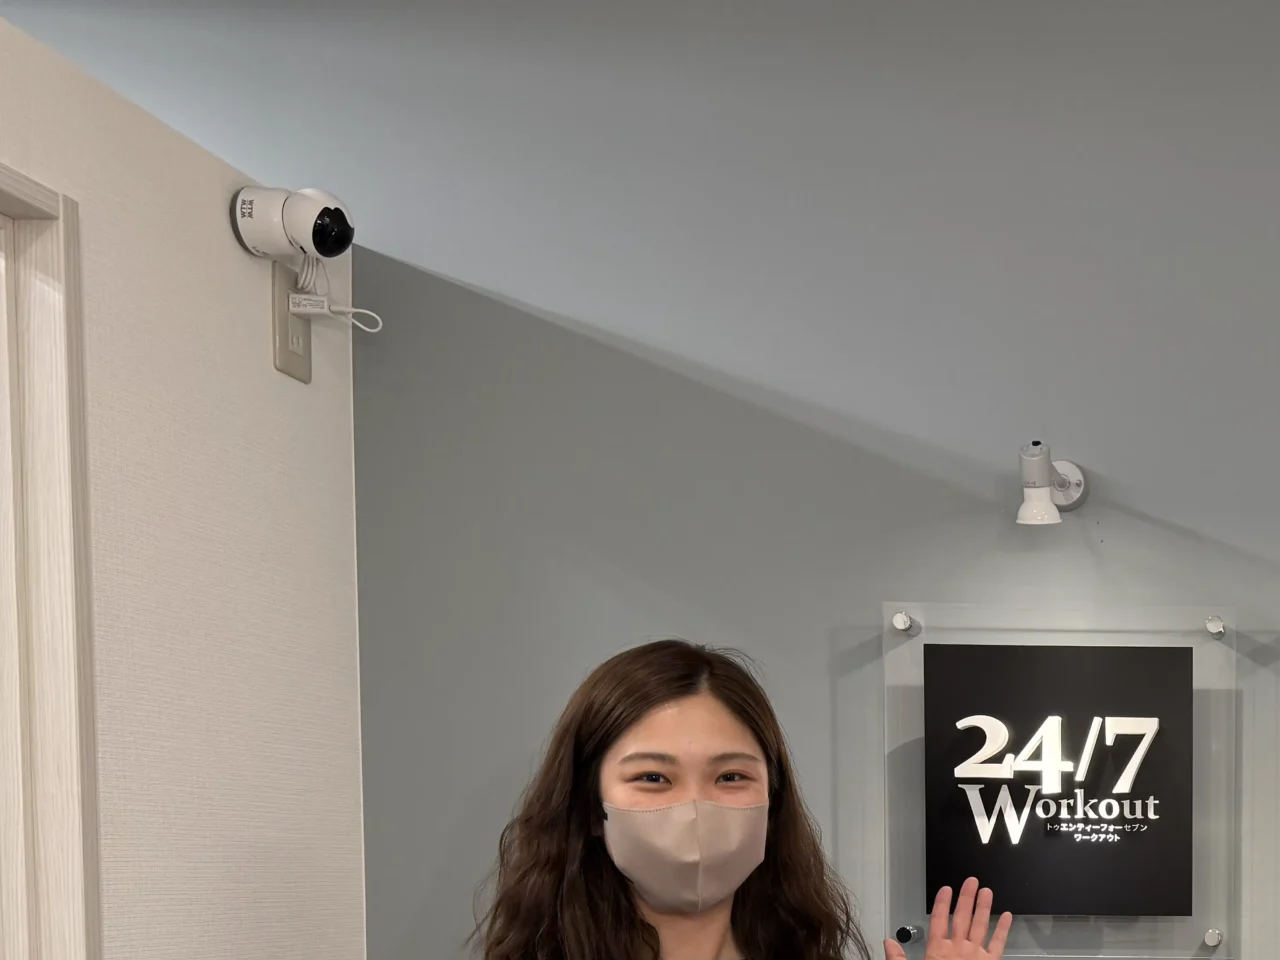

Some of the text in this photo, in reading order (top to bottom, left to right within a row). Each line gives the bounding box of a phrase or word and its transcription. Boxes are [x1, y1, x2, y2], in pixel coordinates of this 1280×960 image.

[954, 714, 1160, 794] 24/7
[957, 783, 1160, 845] Workout
[1073, 832, 1121, 842] ワークアウト
